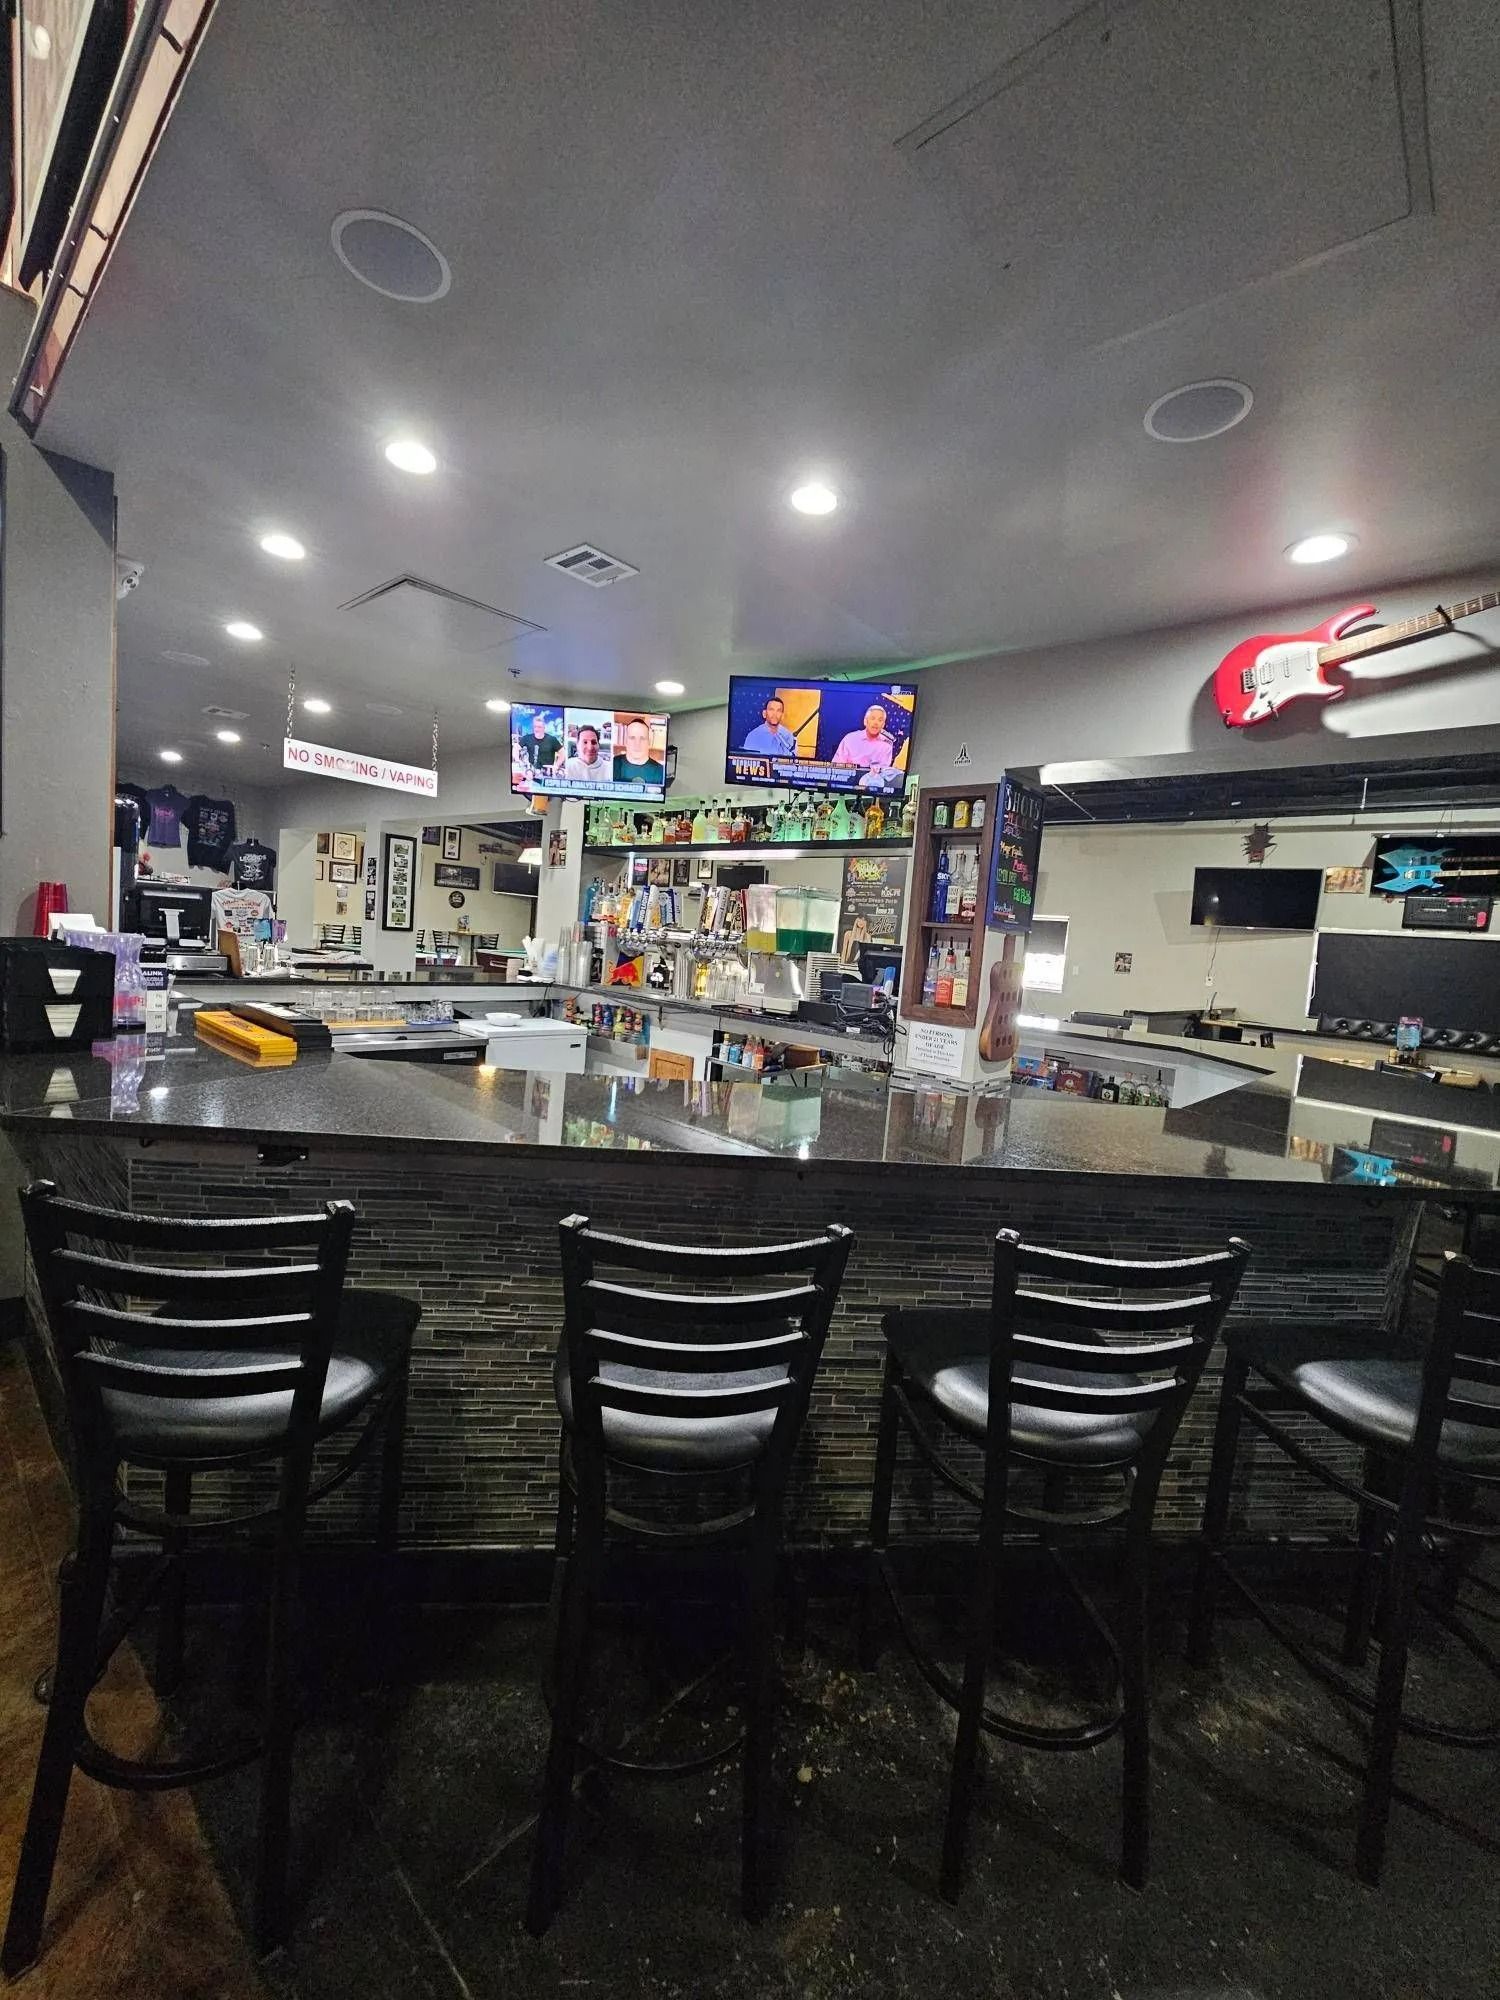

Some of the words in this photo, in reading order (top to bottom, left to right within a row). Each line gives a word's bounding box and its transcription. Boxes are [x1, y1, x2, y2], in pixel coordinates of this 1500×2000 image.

[288, 747, 309, 762] NO
[389, 769, 434, 790] VAPING
[735, 764, 766, 776] NEWS
[1005, 784, 1040, 820] SHOTS
